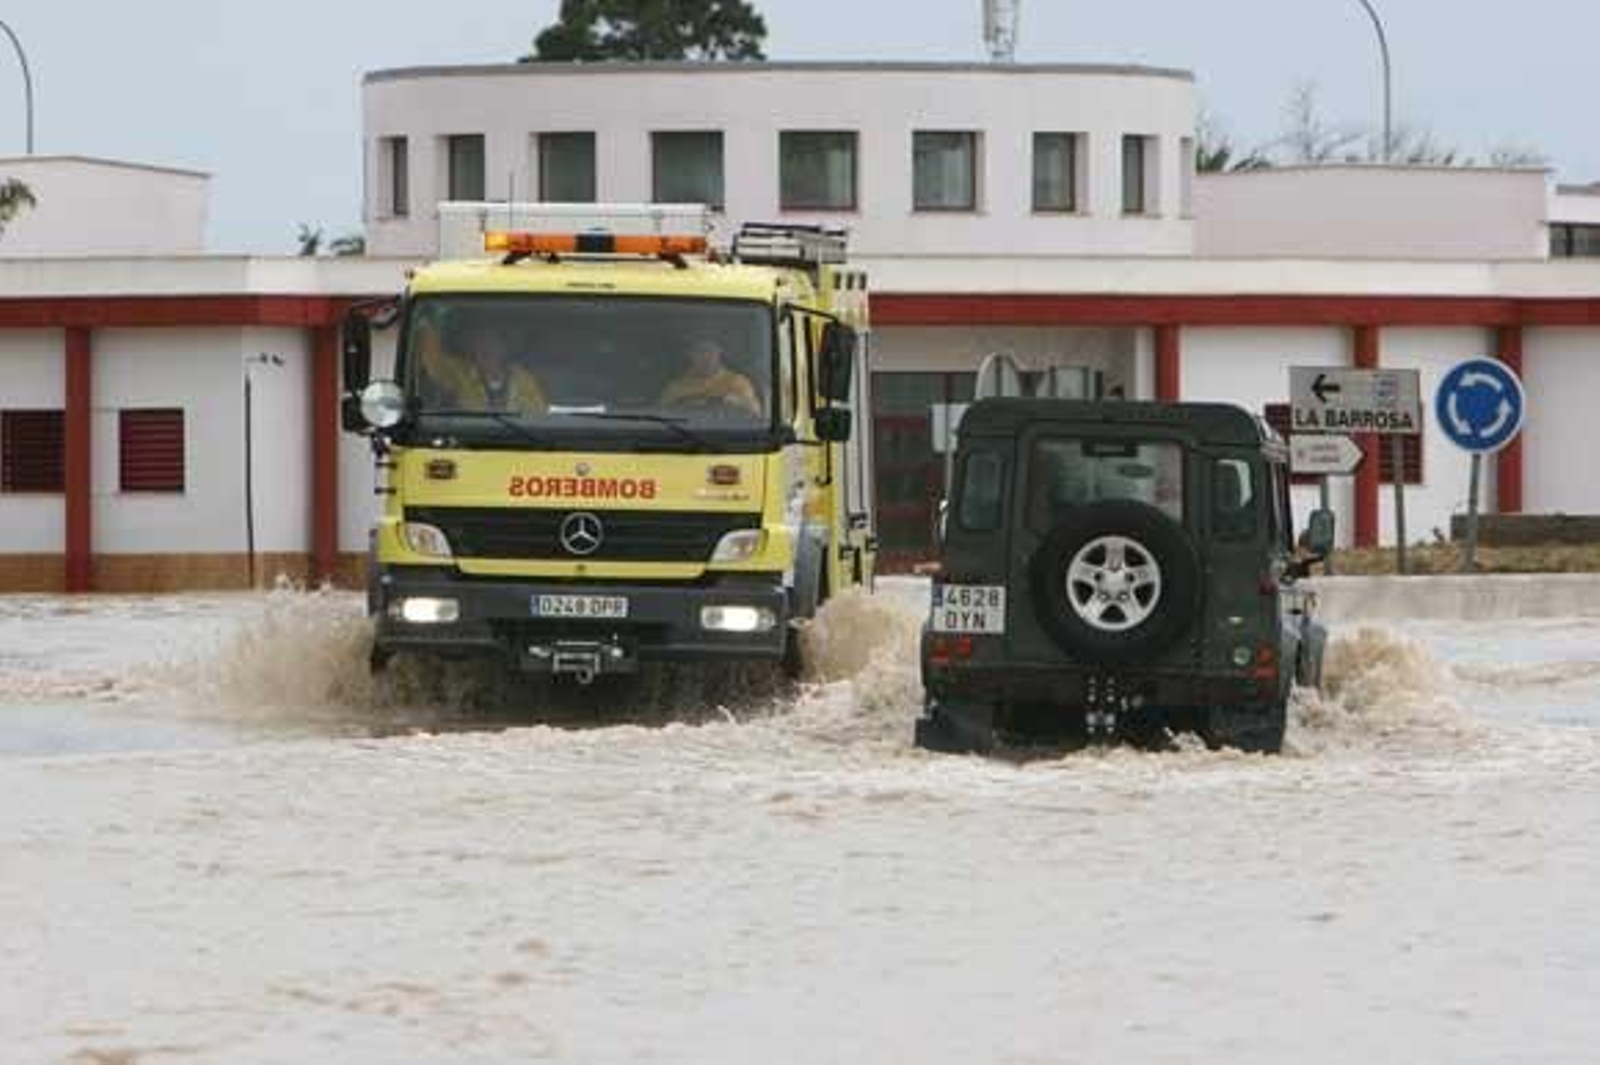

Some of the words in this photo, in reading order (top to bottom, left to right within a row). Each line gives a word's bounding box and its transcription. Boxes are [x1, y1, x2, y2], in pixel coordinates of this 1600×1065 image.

[1294, 408, 1319, 427] LA
[1324, 409, 1413, 431] BARROSA
[946, 588, 999, 607] 4628
